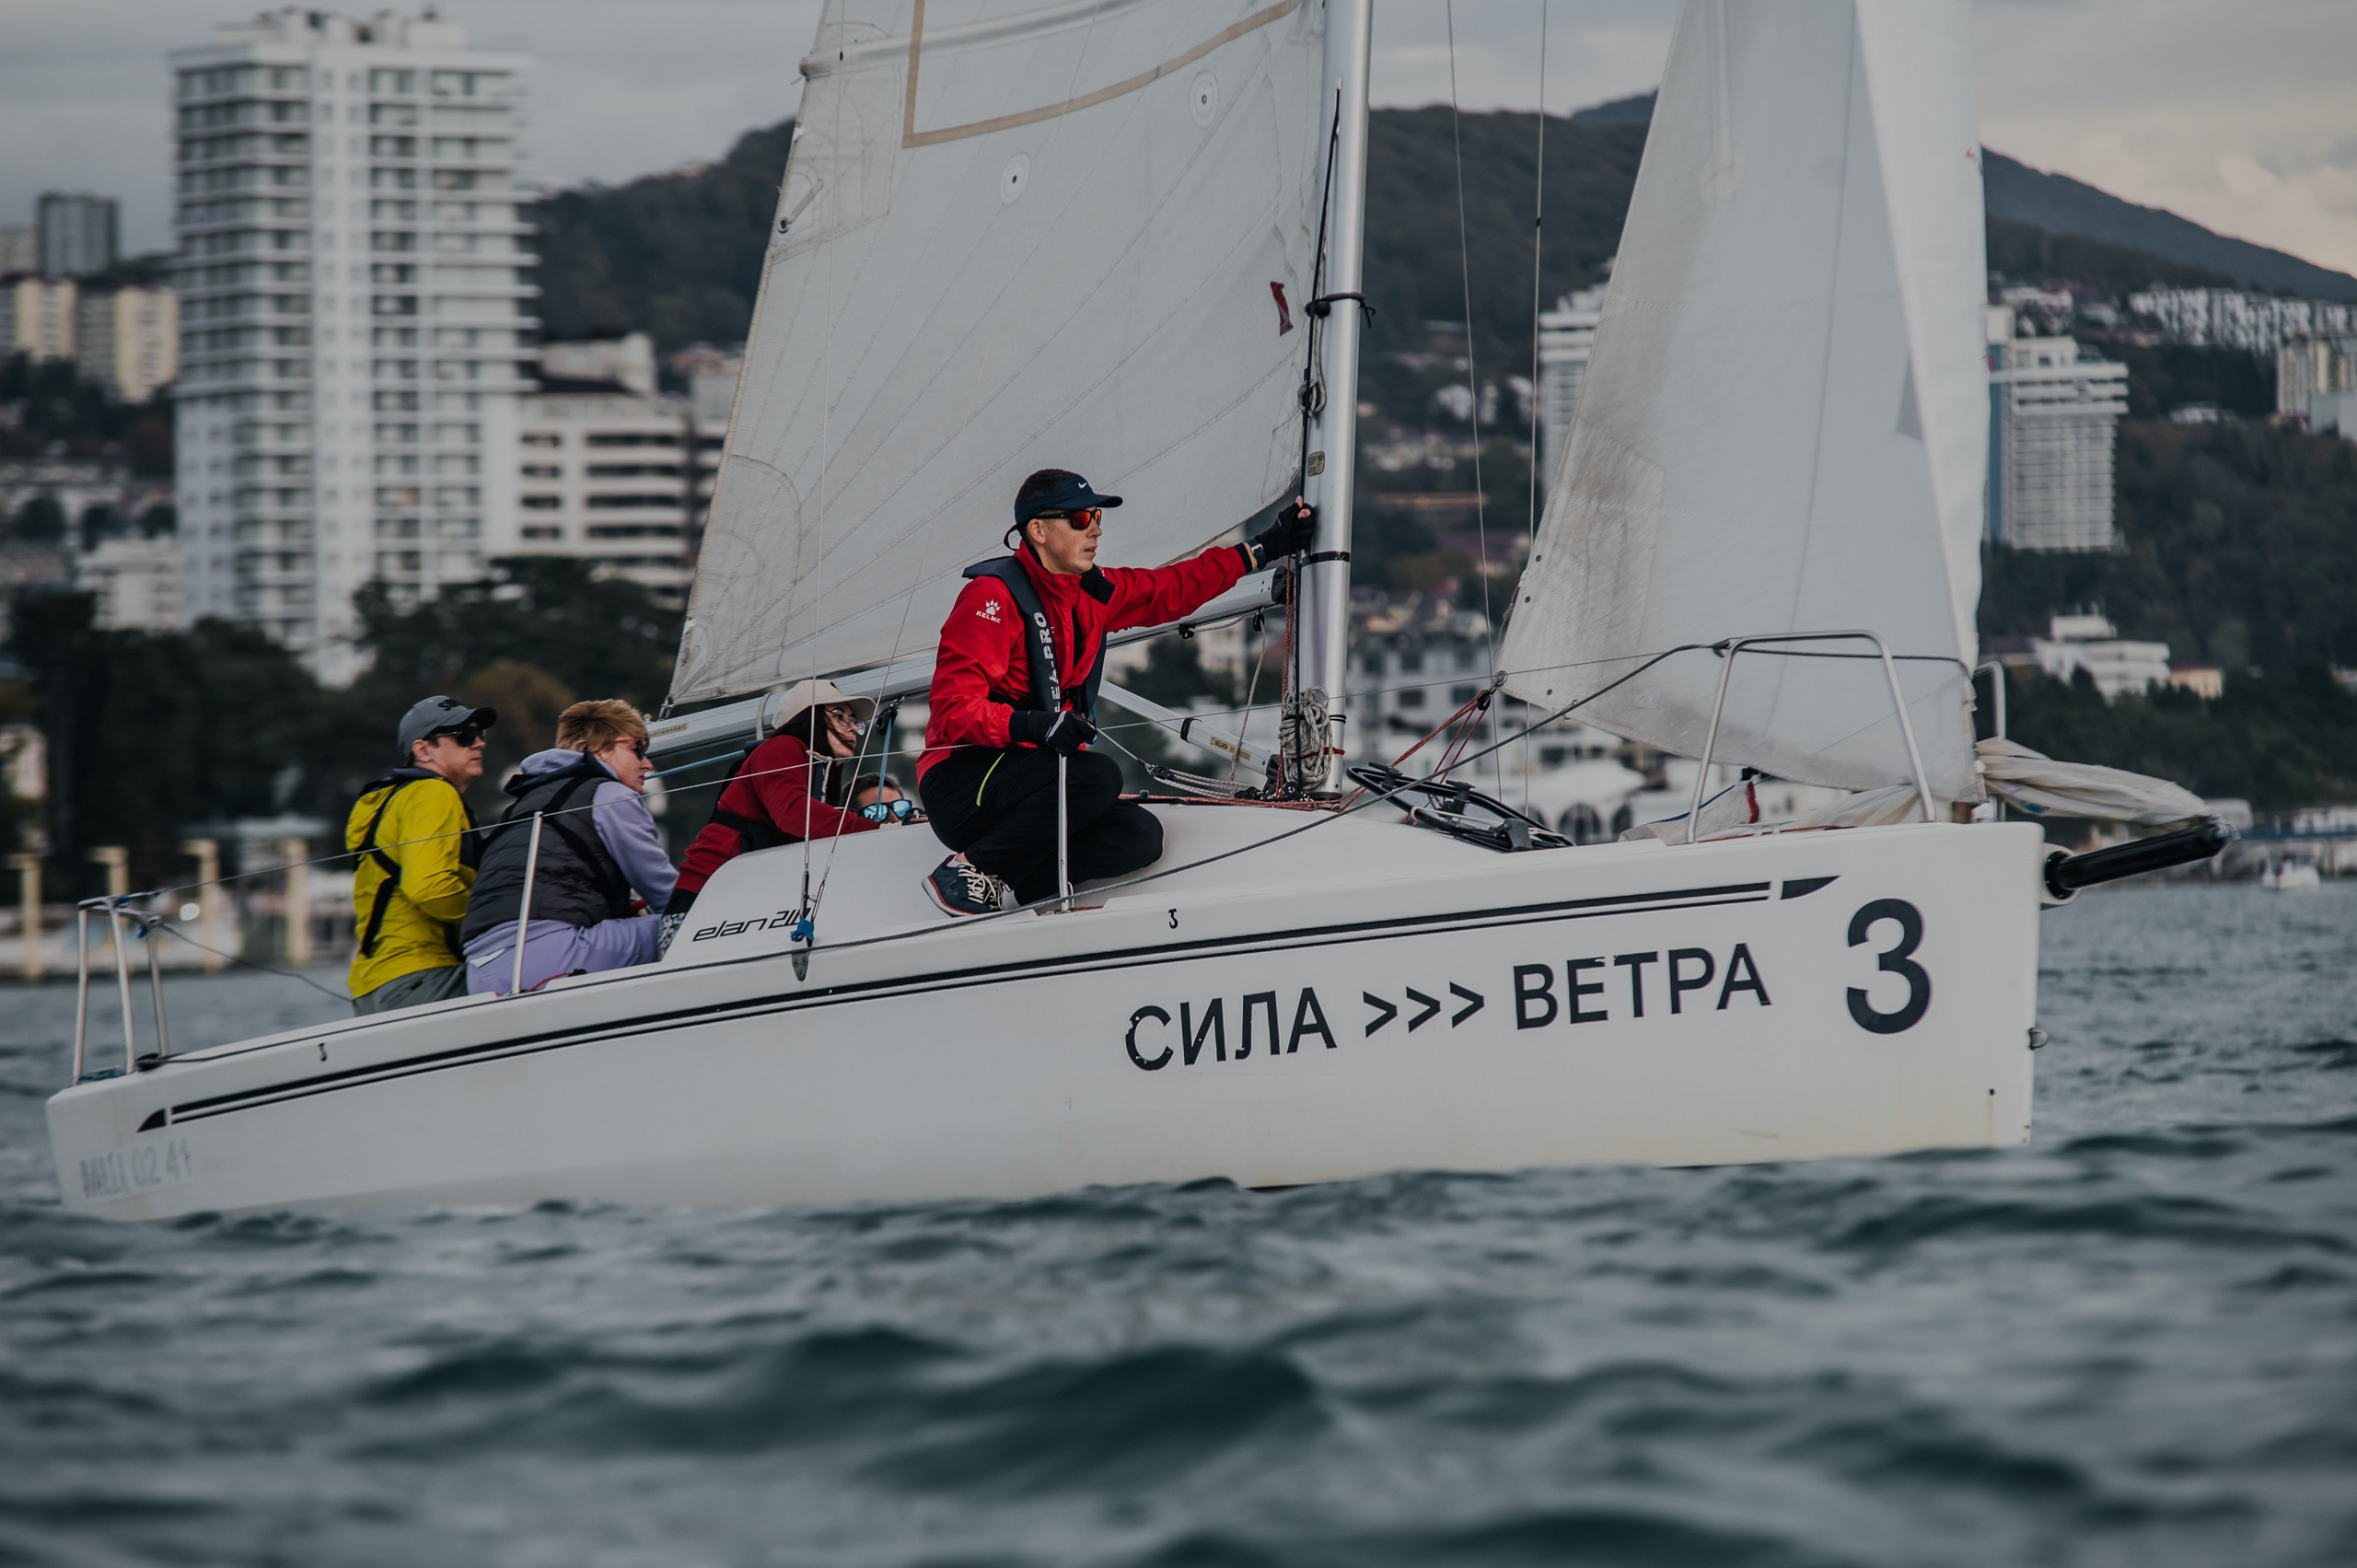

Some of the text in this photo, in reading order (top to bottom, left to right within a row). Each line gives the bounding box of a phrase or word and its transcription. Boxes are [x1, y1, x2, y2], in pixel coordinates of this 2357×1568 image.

[976, 610, 1002, 624] KELME
[692, 918, 768, 942] elan
[1846, 898, 1932, 1035] 3
[1125, 943, 1772, 1071] СИЛА ВЕТРА
